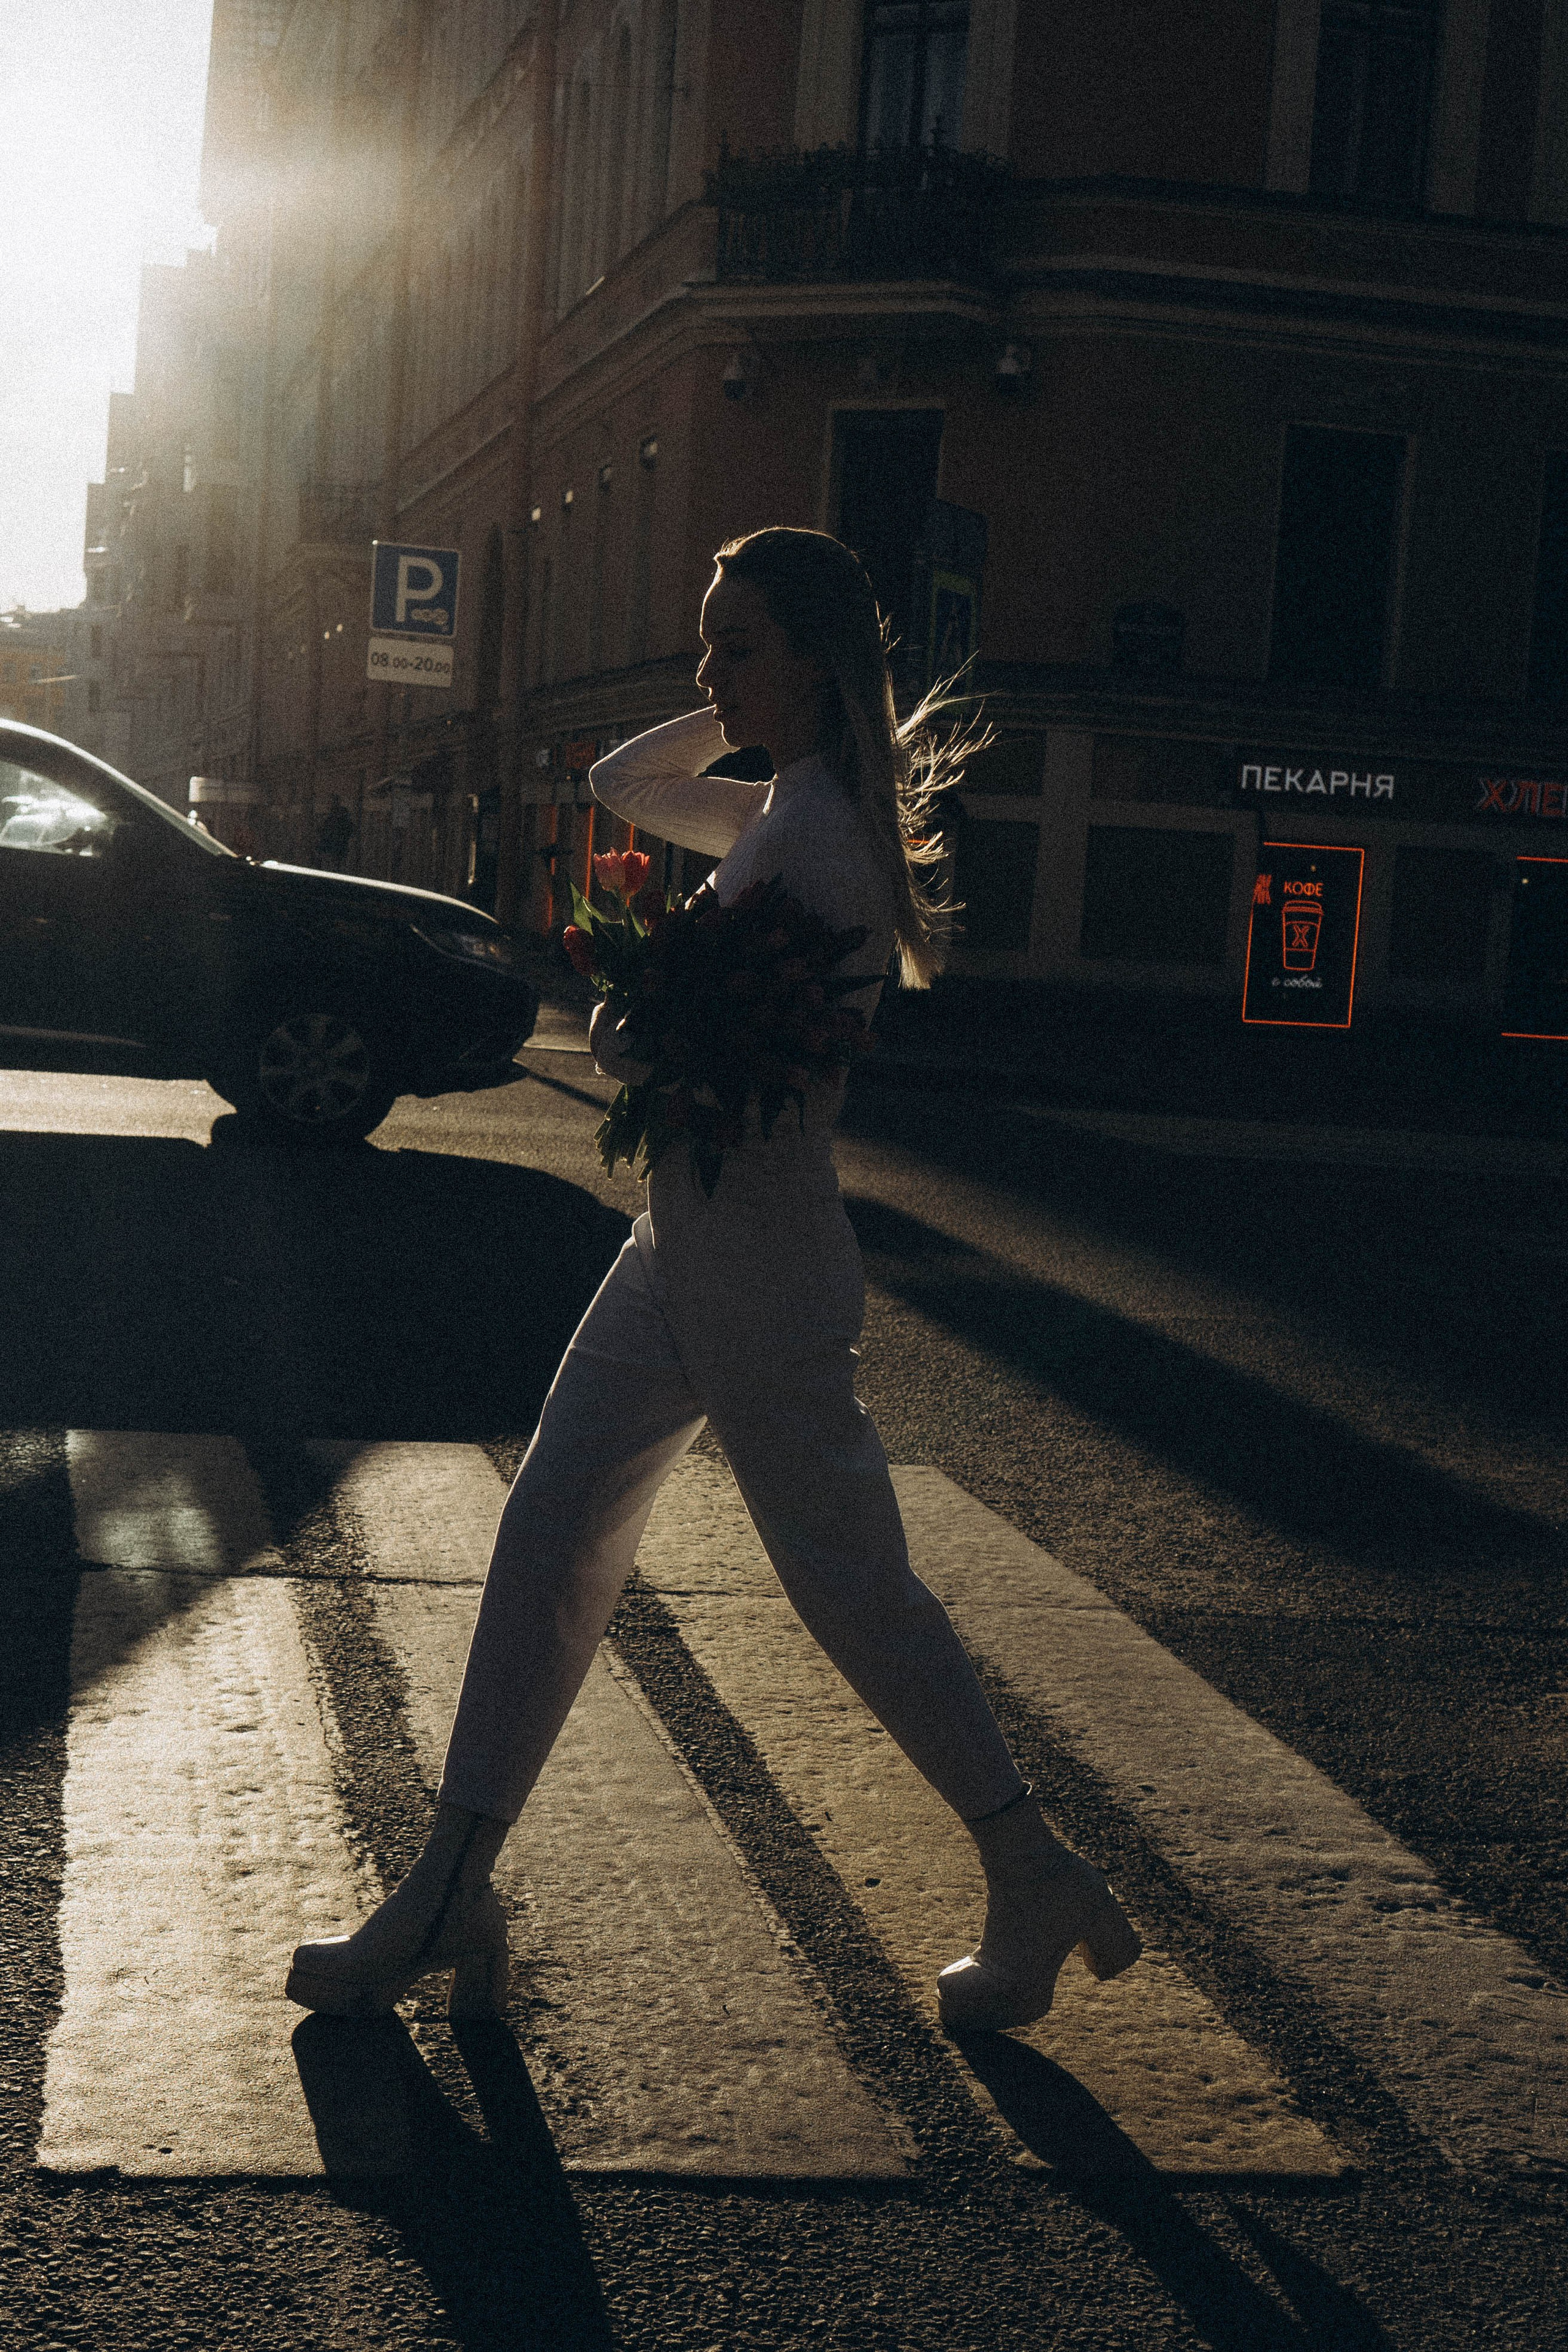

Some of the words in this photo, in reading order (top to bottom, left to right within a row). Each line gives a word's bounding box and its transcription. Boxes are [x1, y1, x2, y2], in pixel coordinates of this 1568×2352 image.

[396, 555, 444, 623] P
[1241, 764, 1395, 799] ПЕКАРНЯ
[1476, 778, 1568, 816] ХЛЕ
[1283, 881, 1324, 897] КОФЕ
